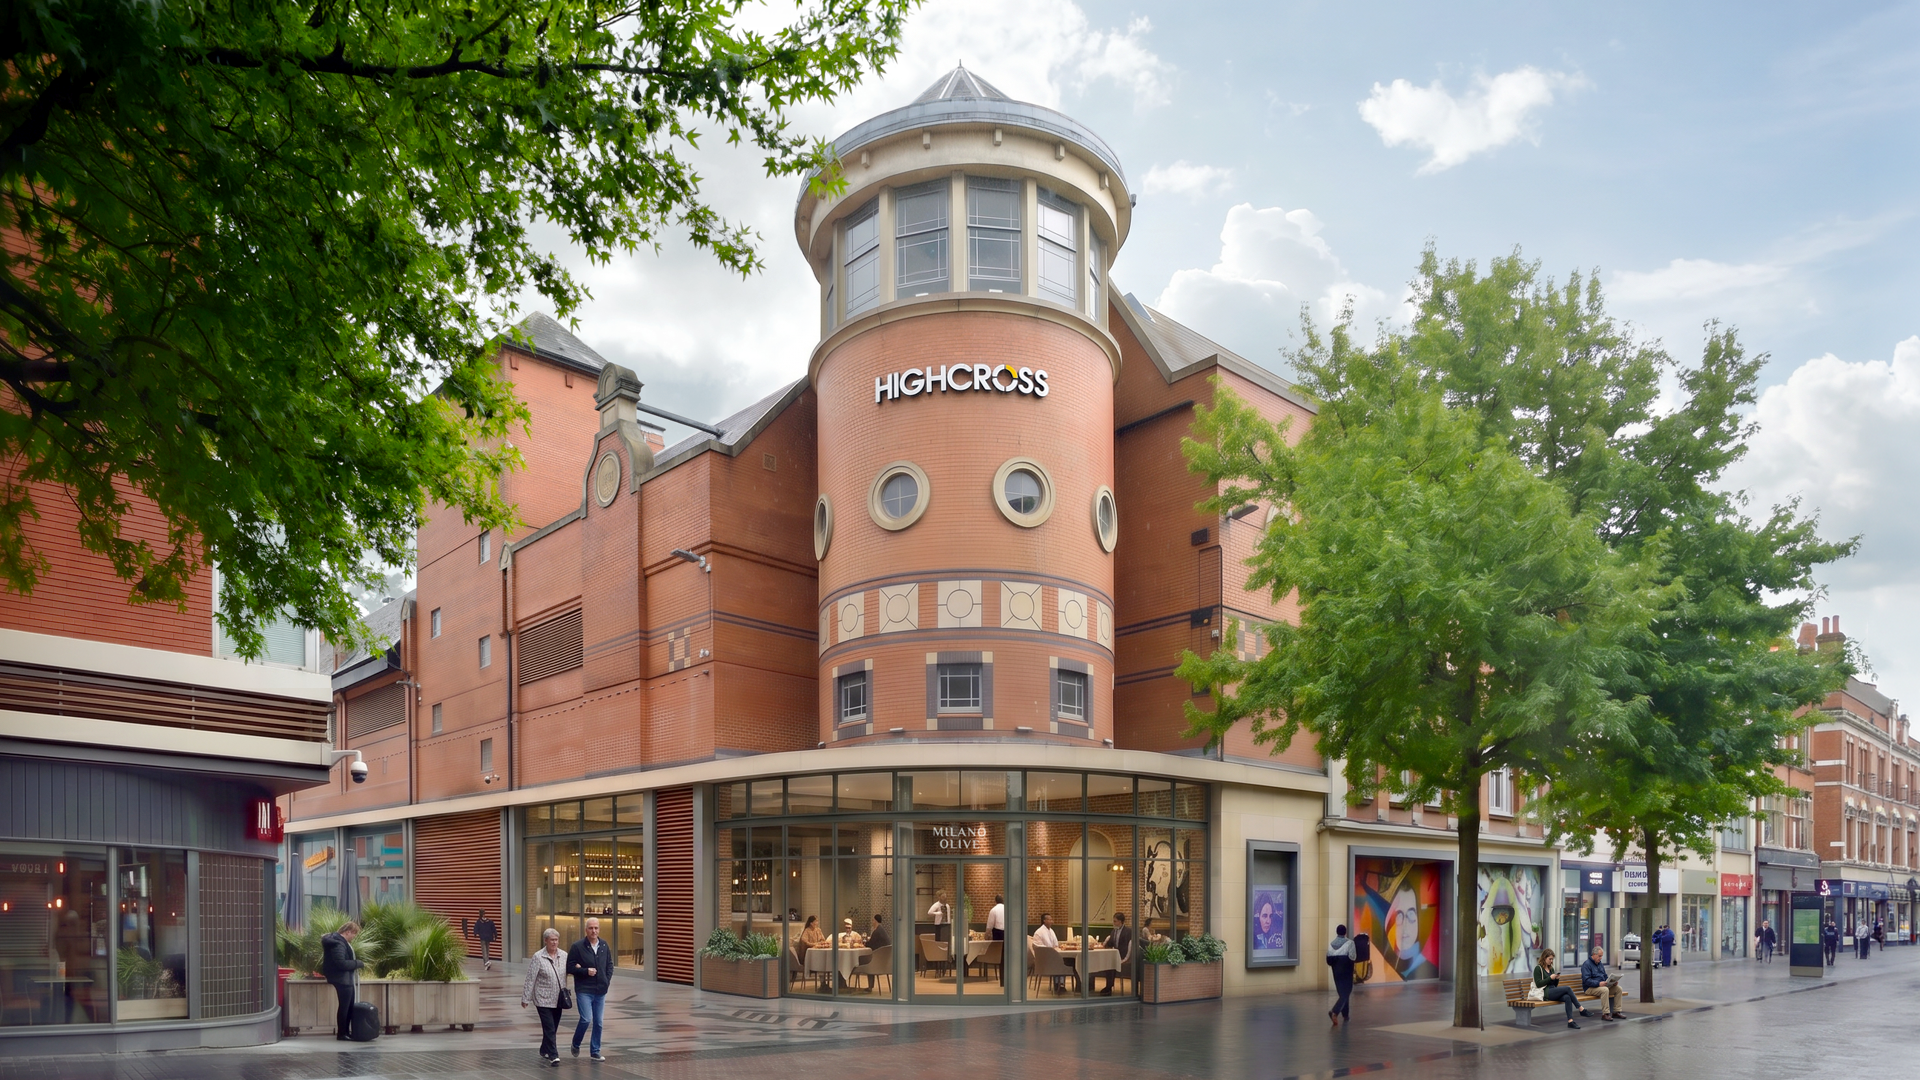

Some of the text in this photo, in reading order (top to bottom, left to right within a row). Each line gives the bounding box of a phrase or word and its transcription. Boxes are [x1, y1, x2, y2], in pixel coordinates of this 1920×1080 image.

[874, 362, 1050, 404] HIGHCROSS
[933, 827, 987, 837] MILANO
[939, 839, 981, 849] OLIVE
